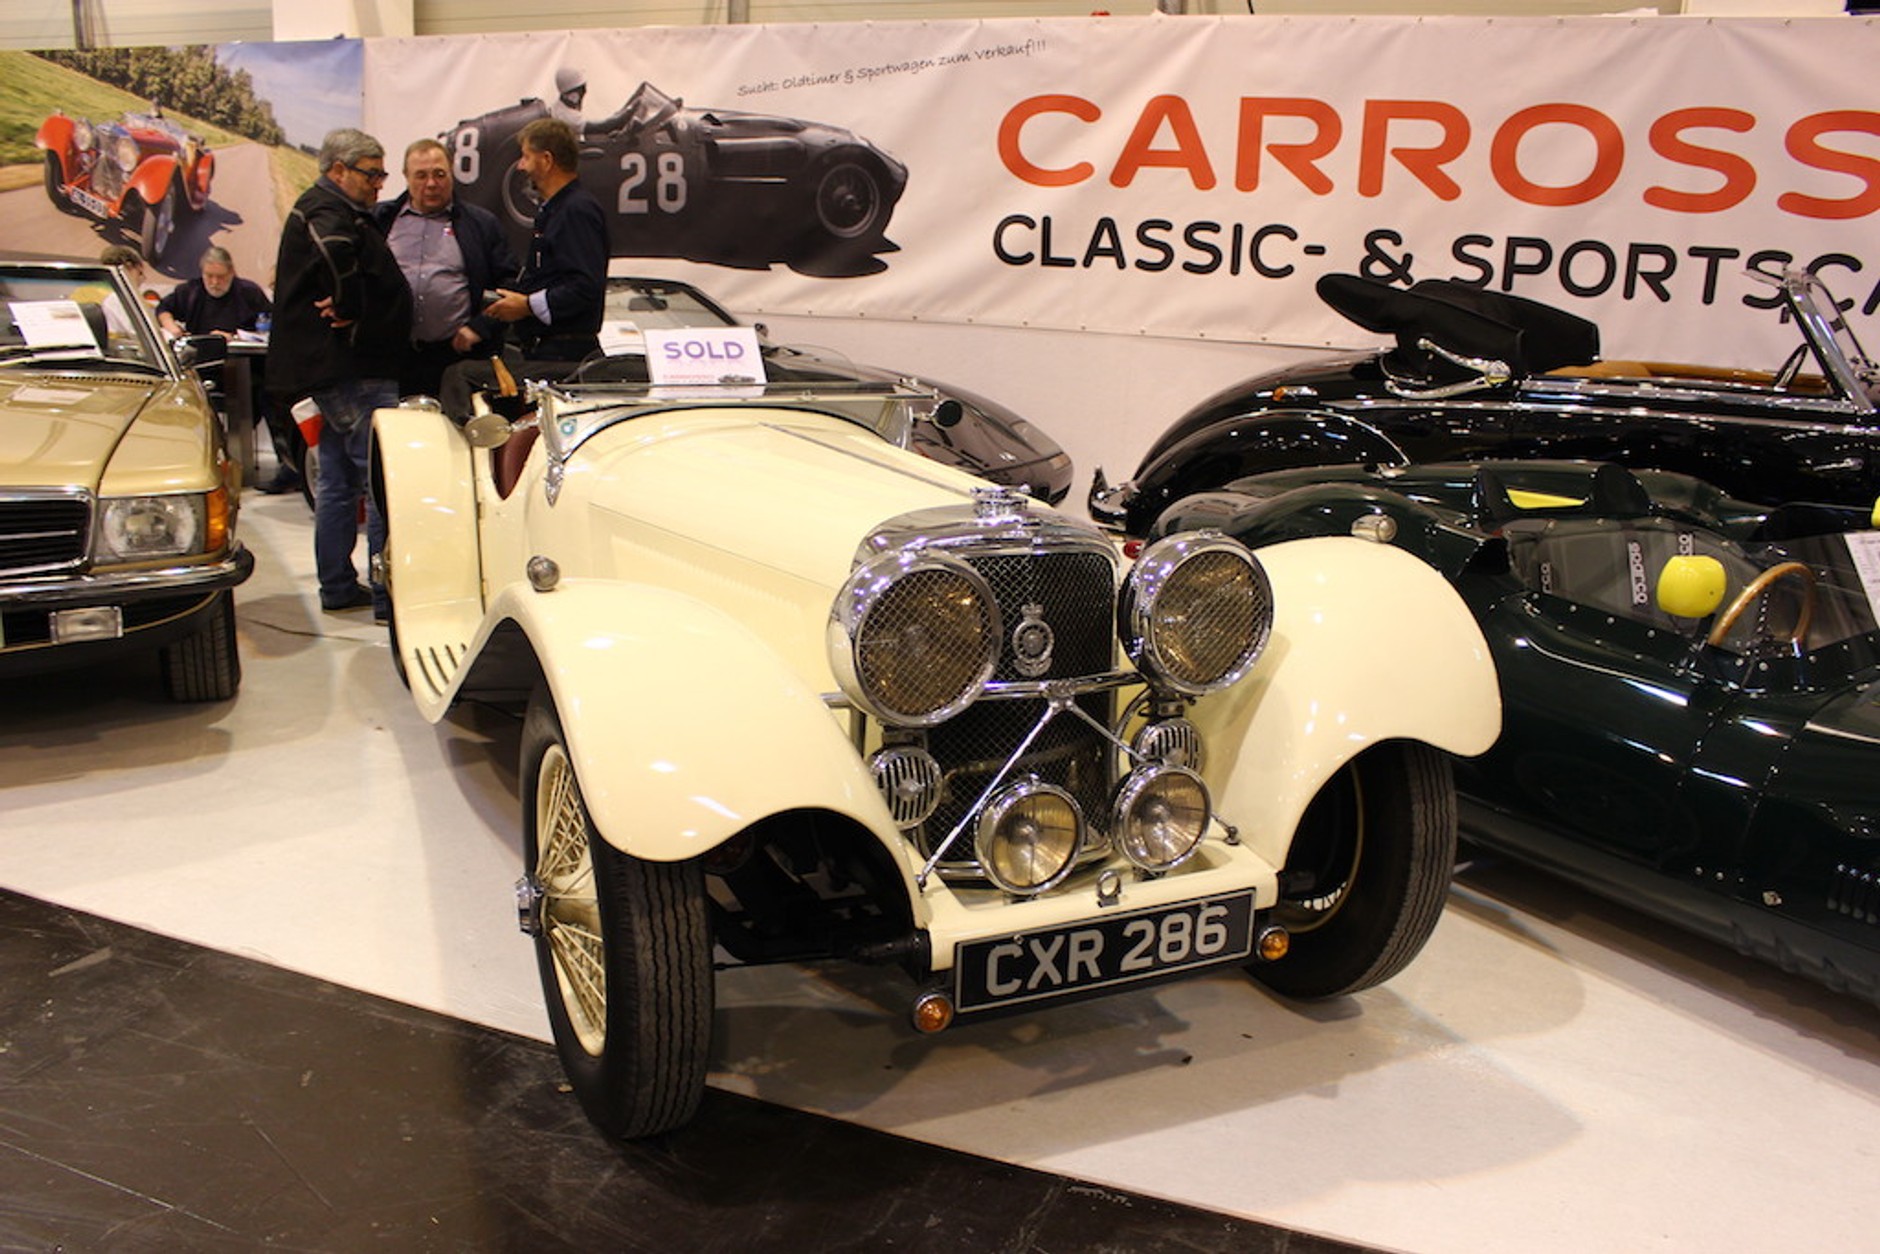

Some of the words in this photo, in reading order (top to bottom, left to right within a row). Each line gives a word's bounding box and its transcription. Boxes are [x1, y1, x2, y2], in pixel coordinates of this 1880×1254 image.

[737, 82, 780, 97] Sucht:
[782, 72, 841, 90] Oldtimer
[856, 60, 935, 81] Sportwagen
[938, 53, 972, 66] zum
[618, 152, 687, 214] 28
[997, 94, 1880, 219] CARROSS
[993, 214, 1326, 279] CLASSIC-
[1360, 229, 1414, 286] &
[663, 341, 745, 360] SOLD
[986, 928, 1106, 998] CXR
[1119, 904, 1230, 972] 286
